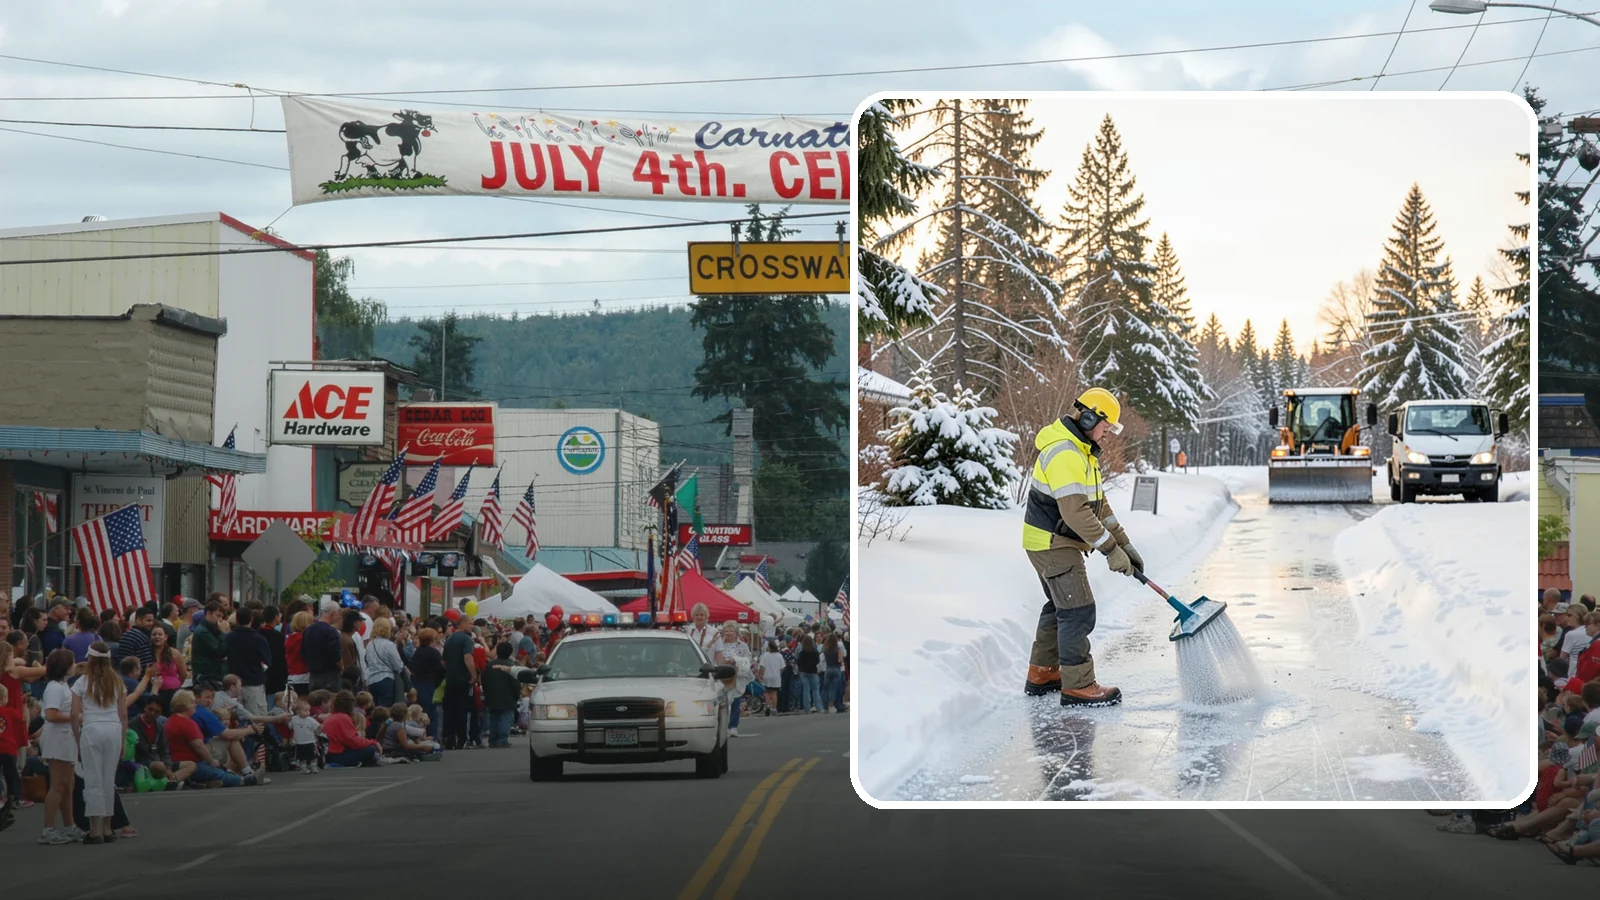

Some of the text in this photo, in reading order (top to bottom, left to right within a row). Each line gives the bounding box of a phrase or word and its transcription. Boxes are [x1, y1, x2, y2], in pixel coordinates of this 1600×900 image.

[481, 140, 605, 193] JULY
[632, 149, 746, 197] 4th.
[696, 254, 850, 280] CROSSWA
[282, 380, 374, 420] ACE
[405, 409, 452, 421] CEDAR
[283, 421, 371, 436] Hardware
[353, 467, 386, 479] Simpl
[95, 485, 124, 495] Vincent
[126, 485, 136, 495] de
[137, 486, 155, 495] Paul
[687, 526, 742, 536] CRNATION
[699, 535, 730, 543] GLASS
